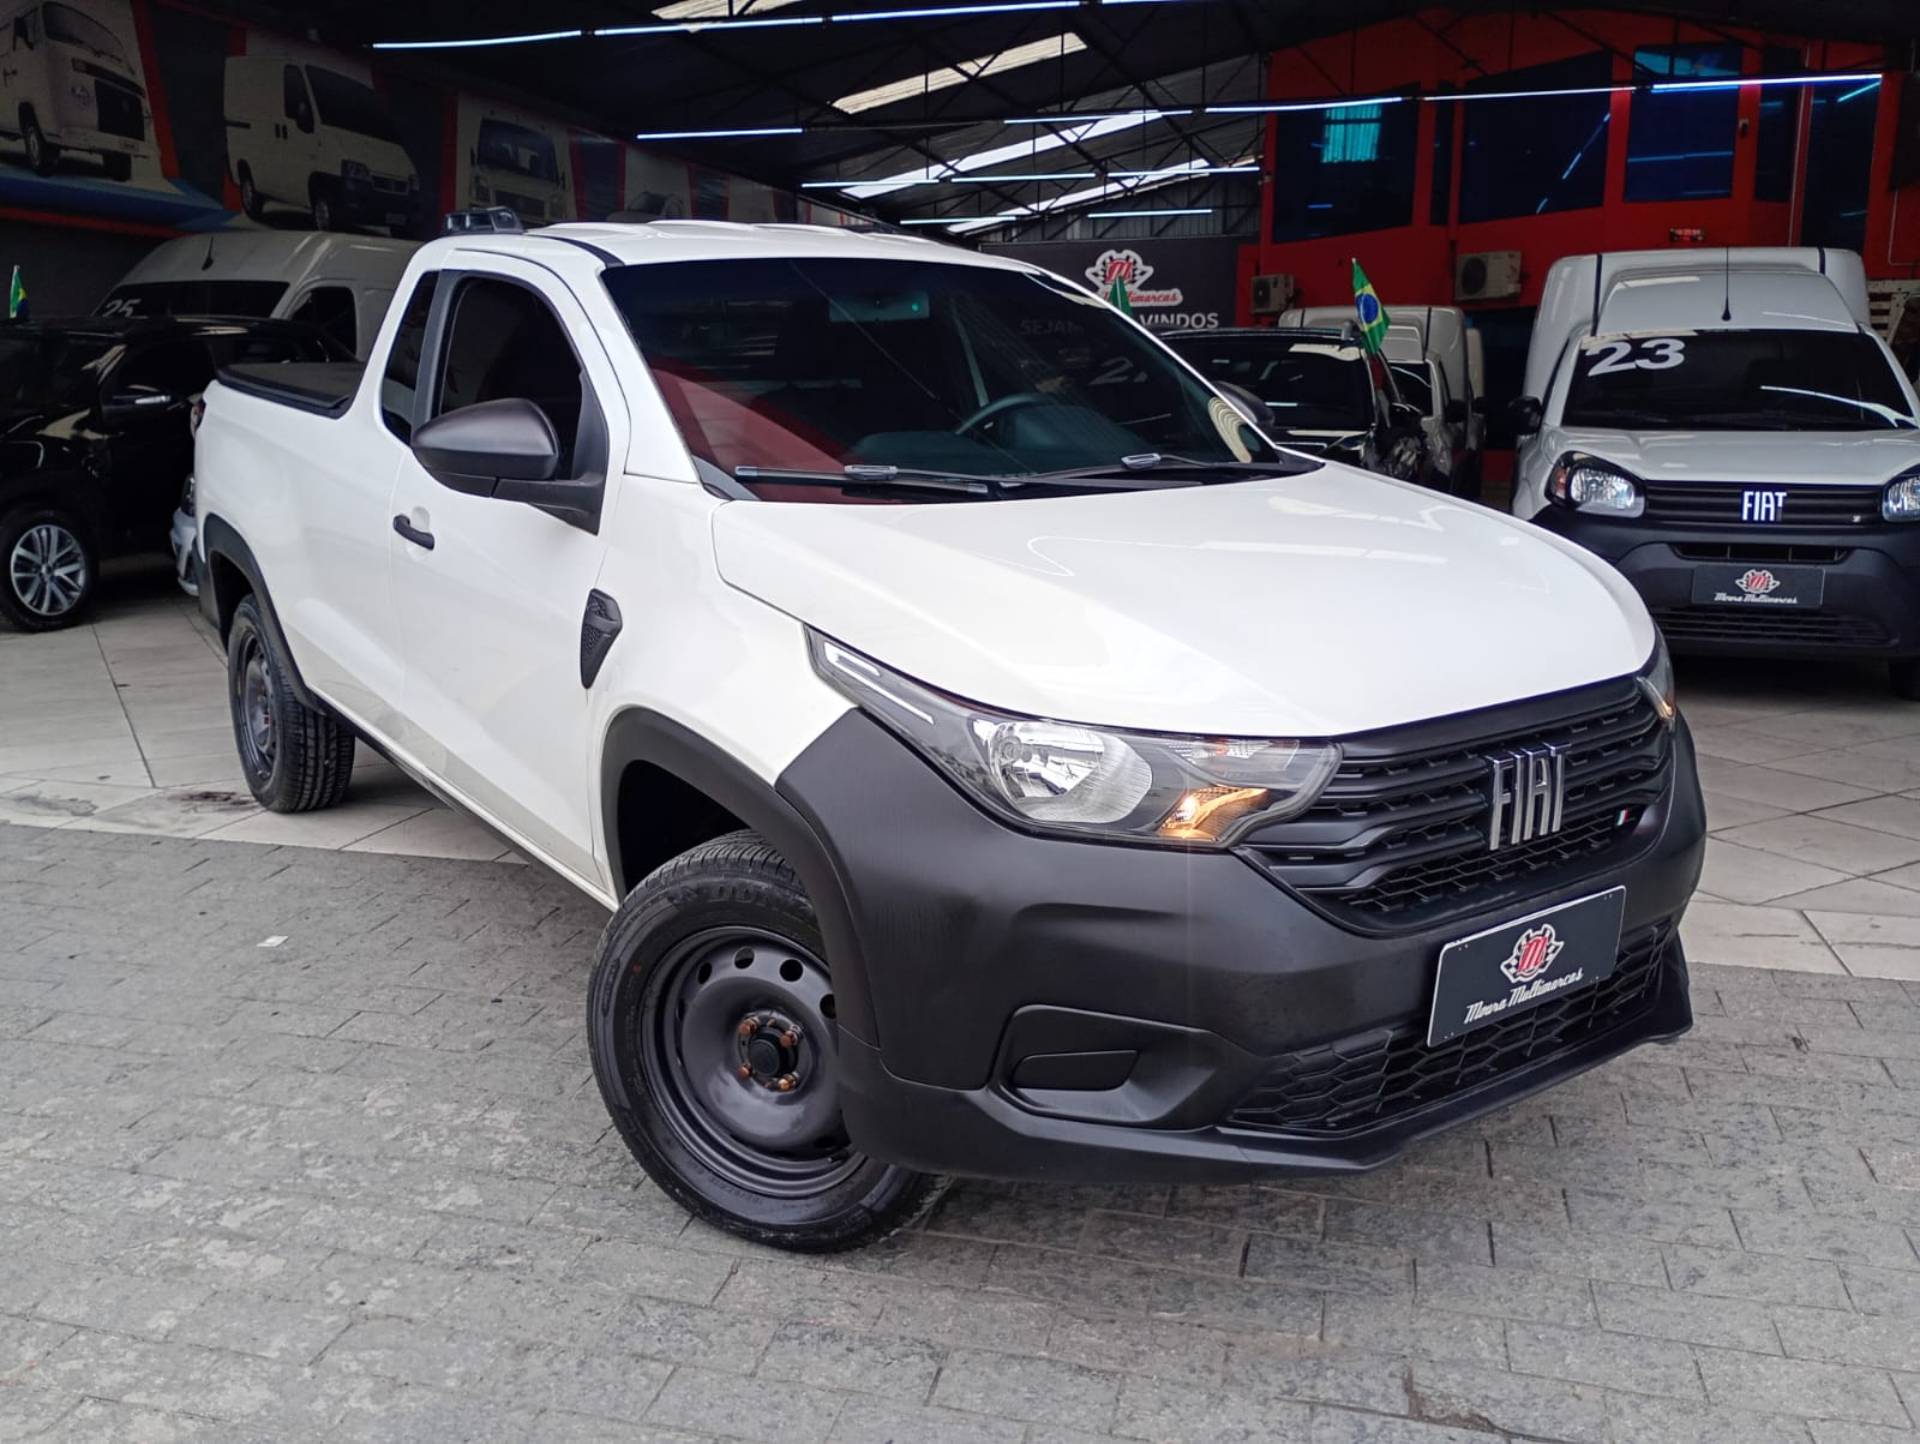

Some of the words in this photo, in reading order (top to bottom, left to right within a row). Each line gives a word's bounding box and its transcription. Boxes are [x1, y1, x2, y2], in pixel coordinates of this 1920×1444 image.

[1140, 312, 1219, 329] VINDOS
[1585, 338, 1685, 376] 23
[1742, 490, 1787, 522] FIAT
[1484, 742, 1571, 851] FIAT
